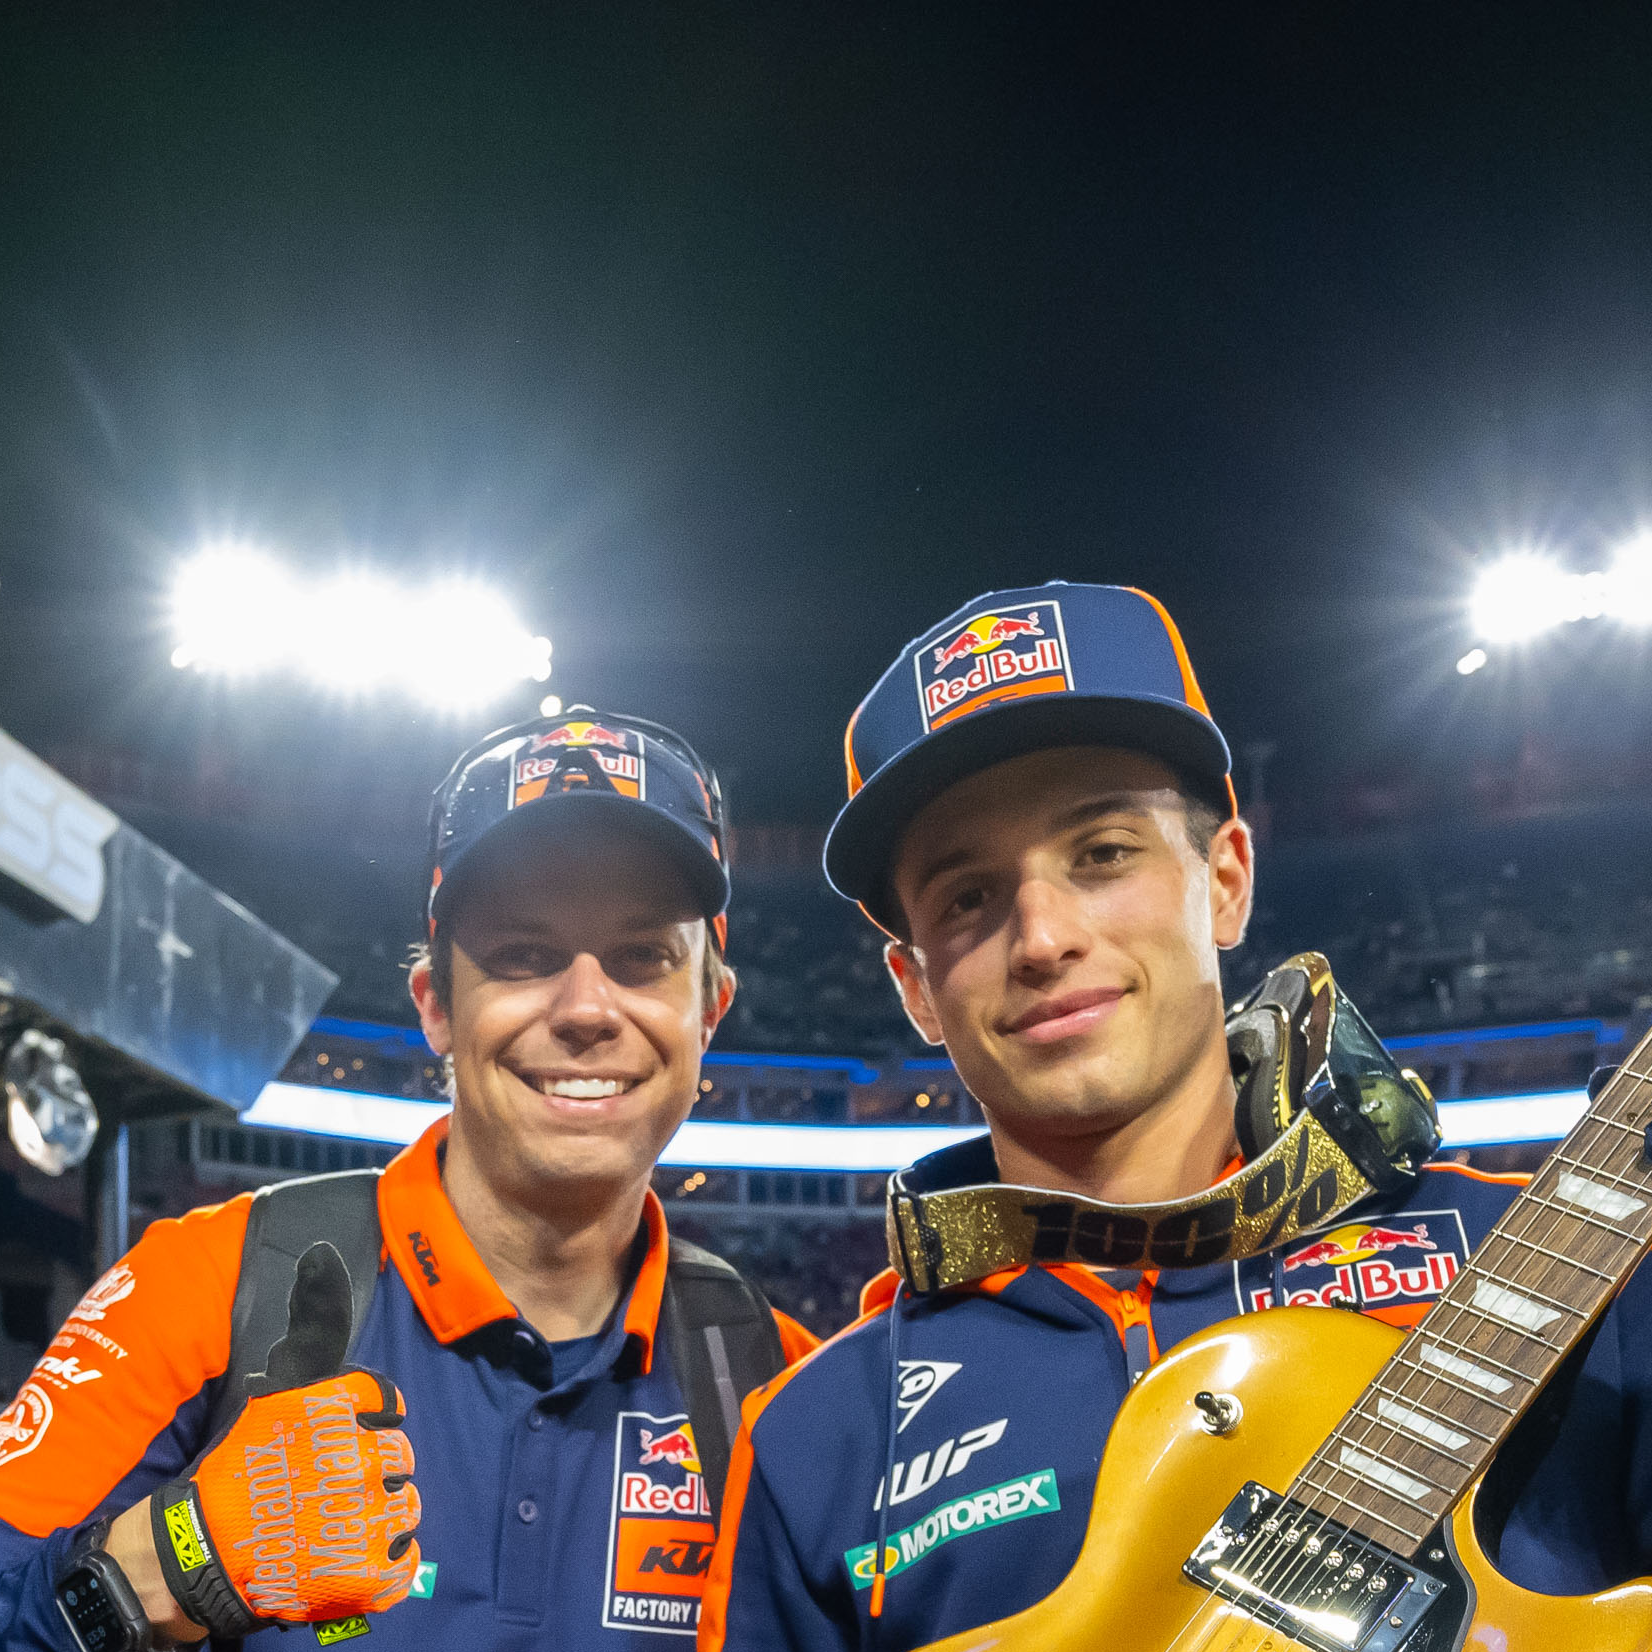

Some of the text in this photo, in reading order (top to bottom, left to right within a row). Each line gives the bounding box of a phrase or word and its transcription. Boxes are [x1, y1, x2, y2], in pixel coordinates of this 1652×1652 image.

[925, 639, 1063, 717] Red Bull
[517, 750, 639, 784] Re ull
[1021, 1122, 1339, 1270] 100%
[408, 1231, 442, 1288] KTM
[1356, 1252, 1460, 1303] Bull
[295, 1386, 371, 1580] Mechanix
[620, 1472, 699, 1515] Red
[873, 1417, 1009, 1512] WP
[232, 1432, 298, 1612] Mechanix
[899, 1475, 1051, 1565] MOTOREX
[612, 1595, 692, 1624] FACTORY
